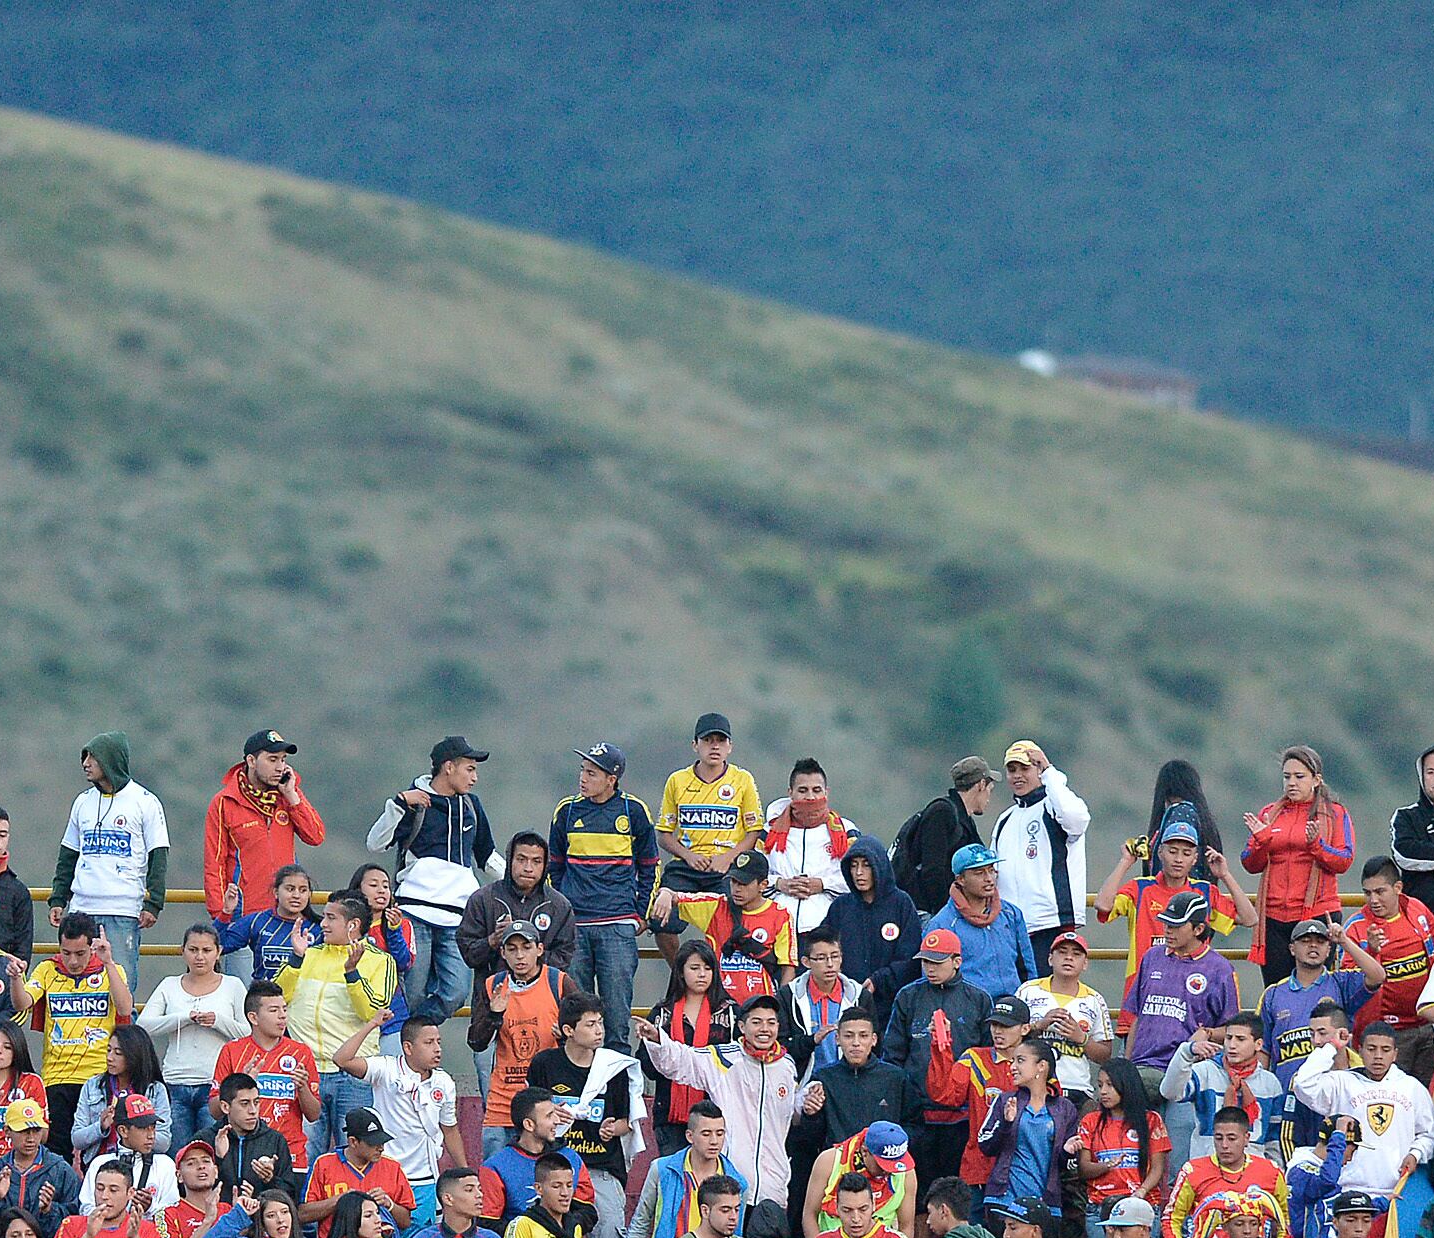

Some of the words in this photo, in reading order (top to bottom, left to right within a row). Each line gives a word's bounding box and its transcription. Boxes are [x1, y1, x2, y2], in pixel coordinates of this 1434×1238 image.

[680, 808, 736, 825] NARIÑO
[50, 997, 108, 1013] NARIÑO
[1145, 995, 1187, 1008] AGRICOLA
